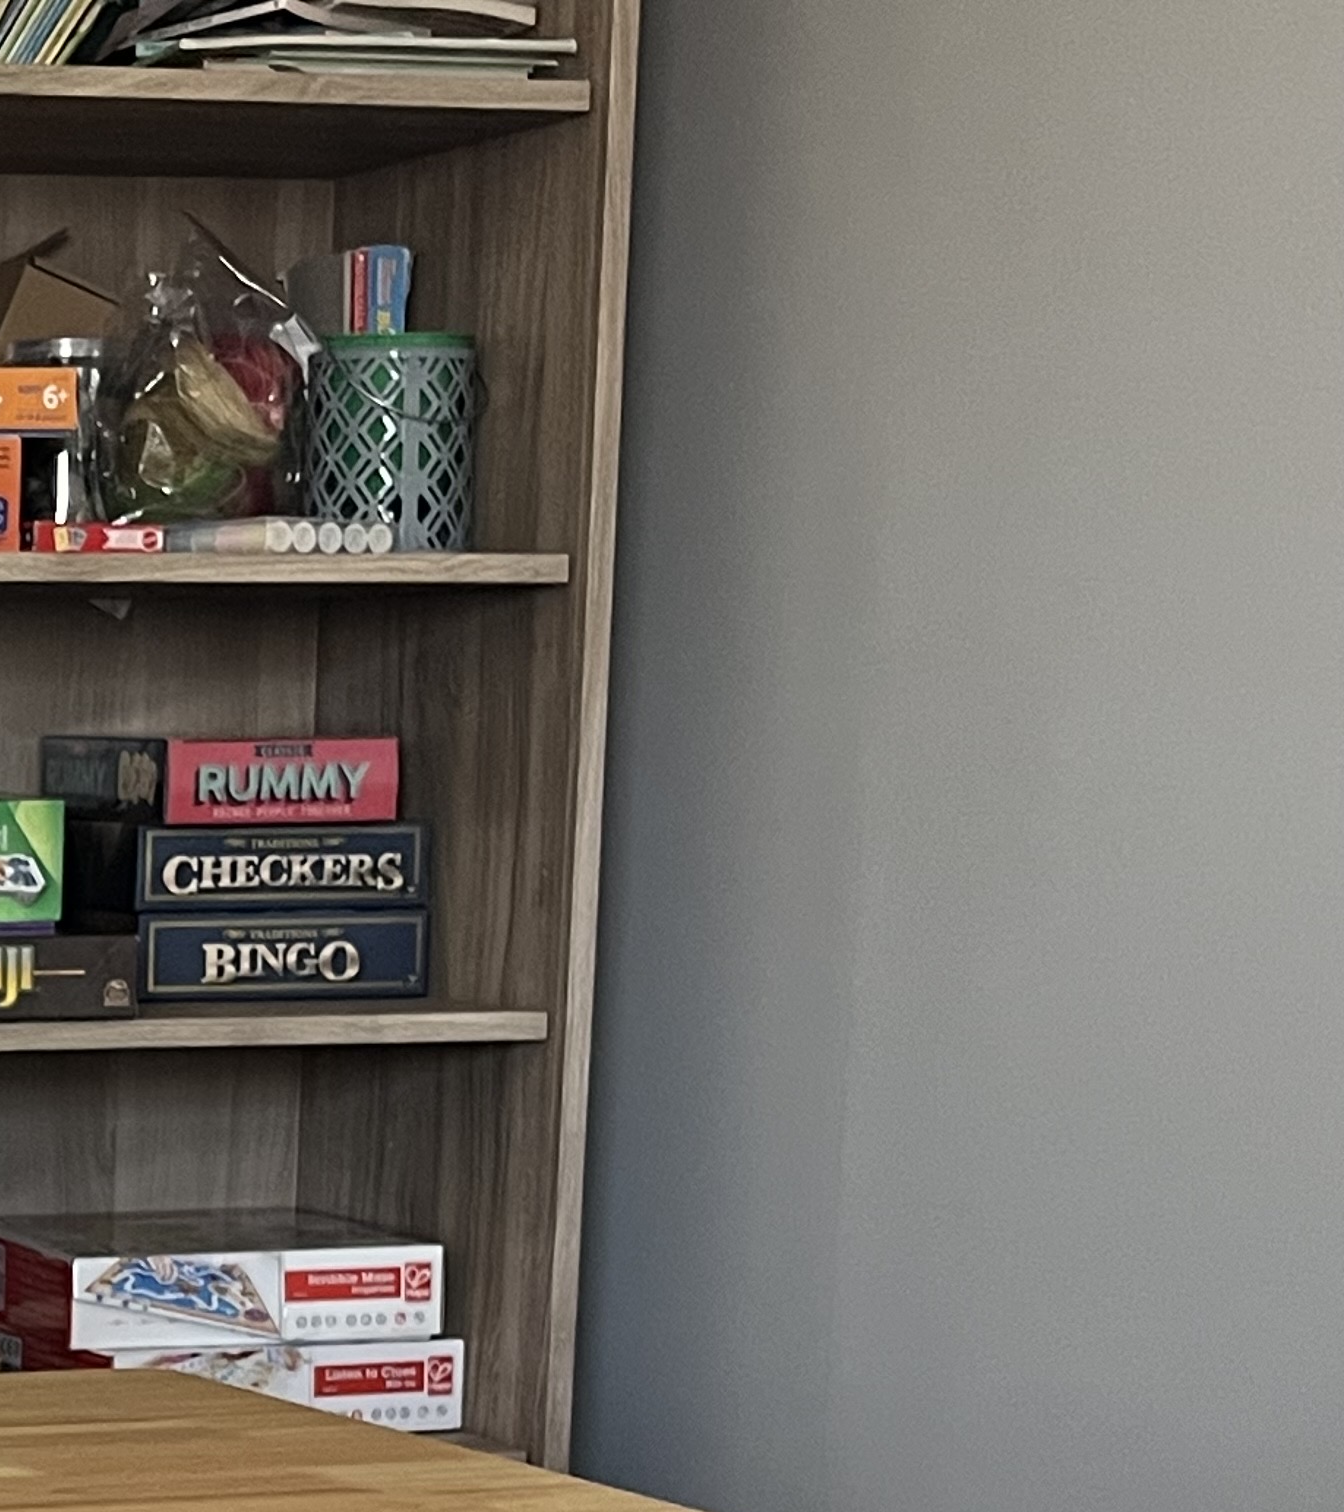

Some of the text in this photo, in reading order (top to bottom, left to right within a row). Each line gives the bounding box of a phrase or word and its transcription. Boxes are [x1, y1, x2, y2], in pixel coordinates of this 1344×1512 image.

[42, 384, 69, 410] 6+
[196, 760, 370, 803] RUMMY
[162, 852, 405, 896] CHECKERS
[201, 940, 360, 984] BINGO
